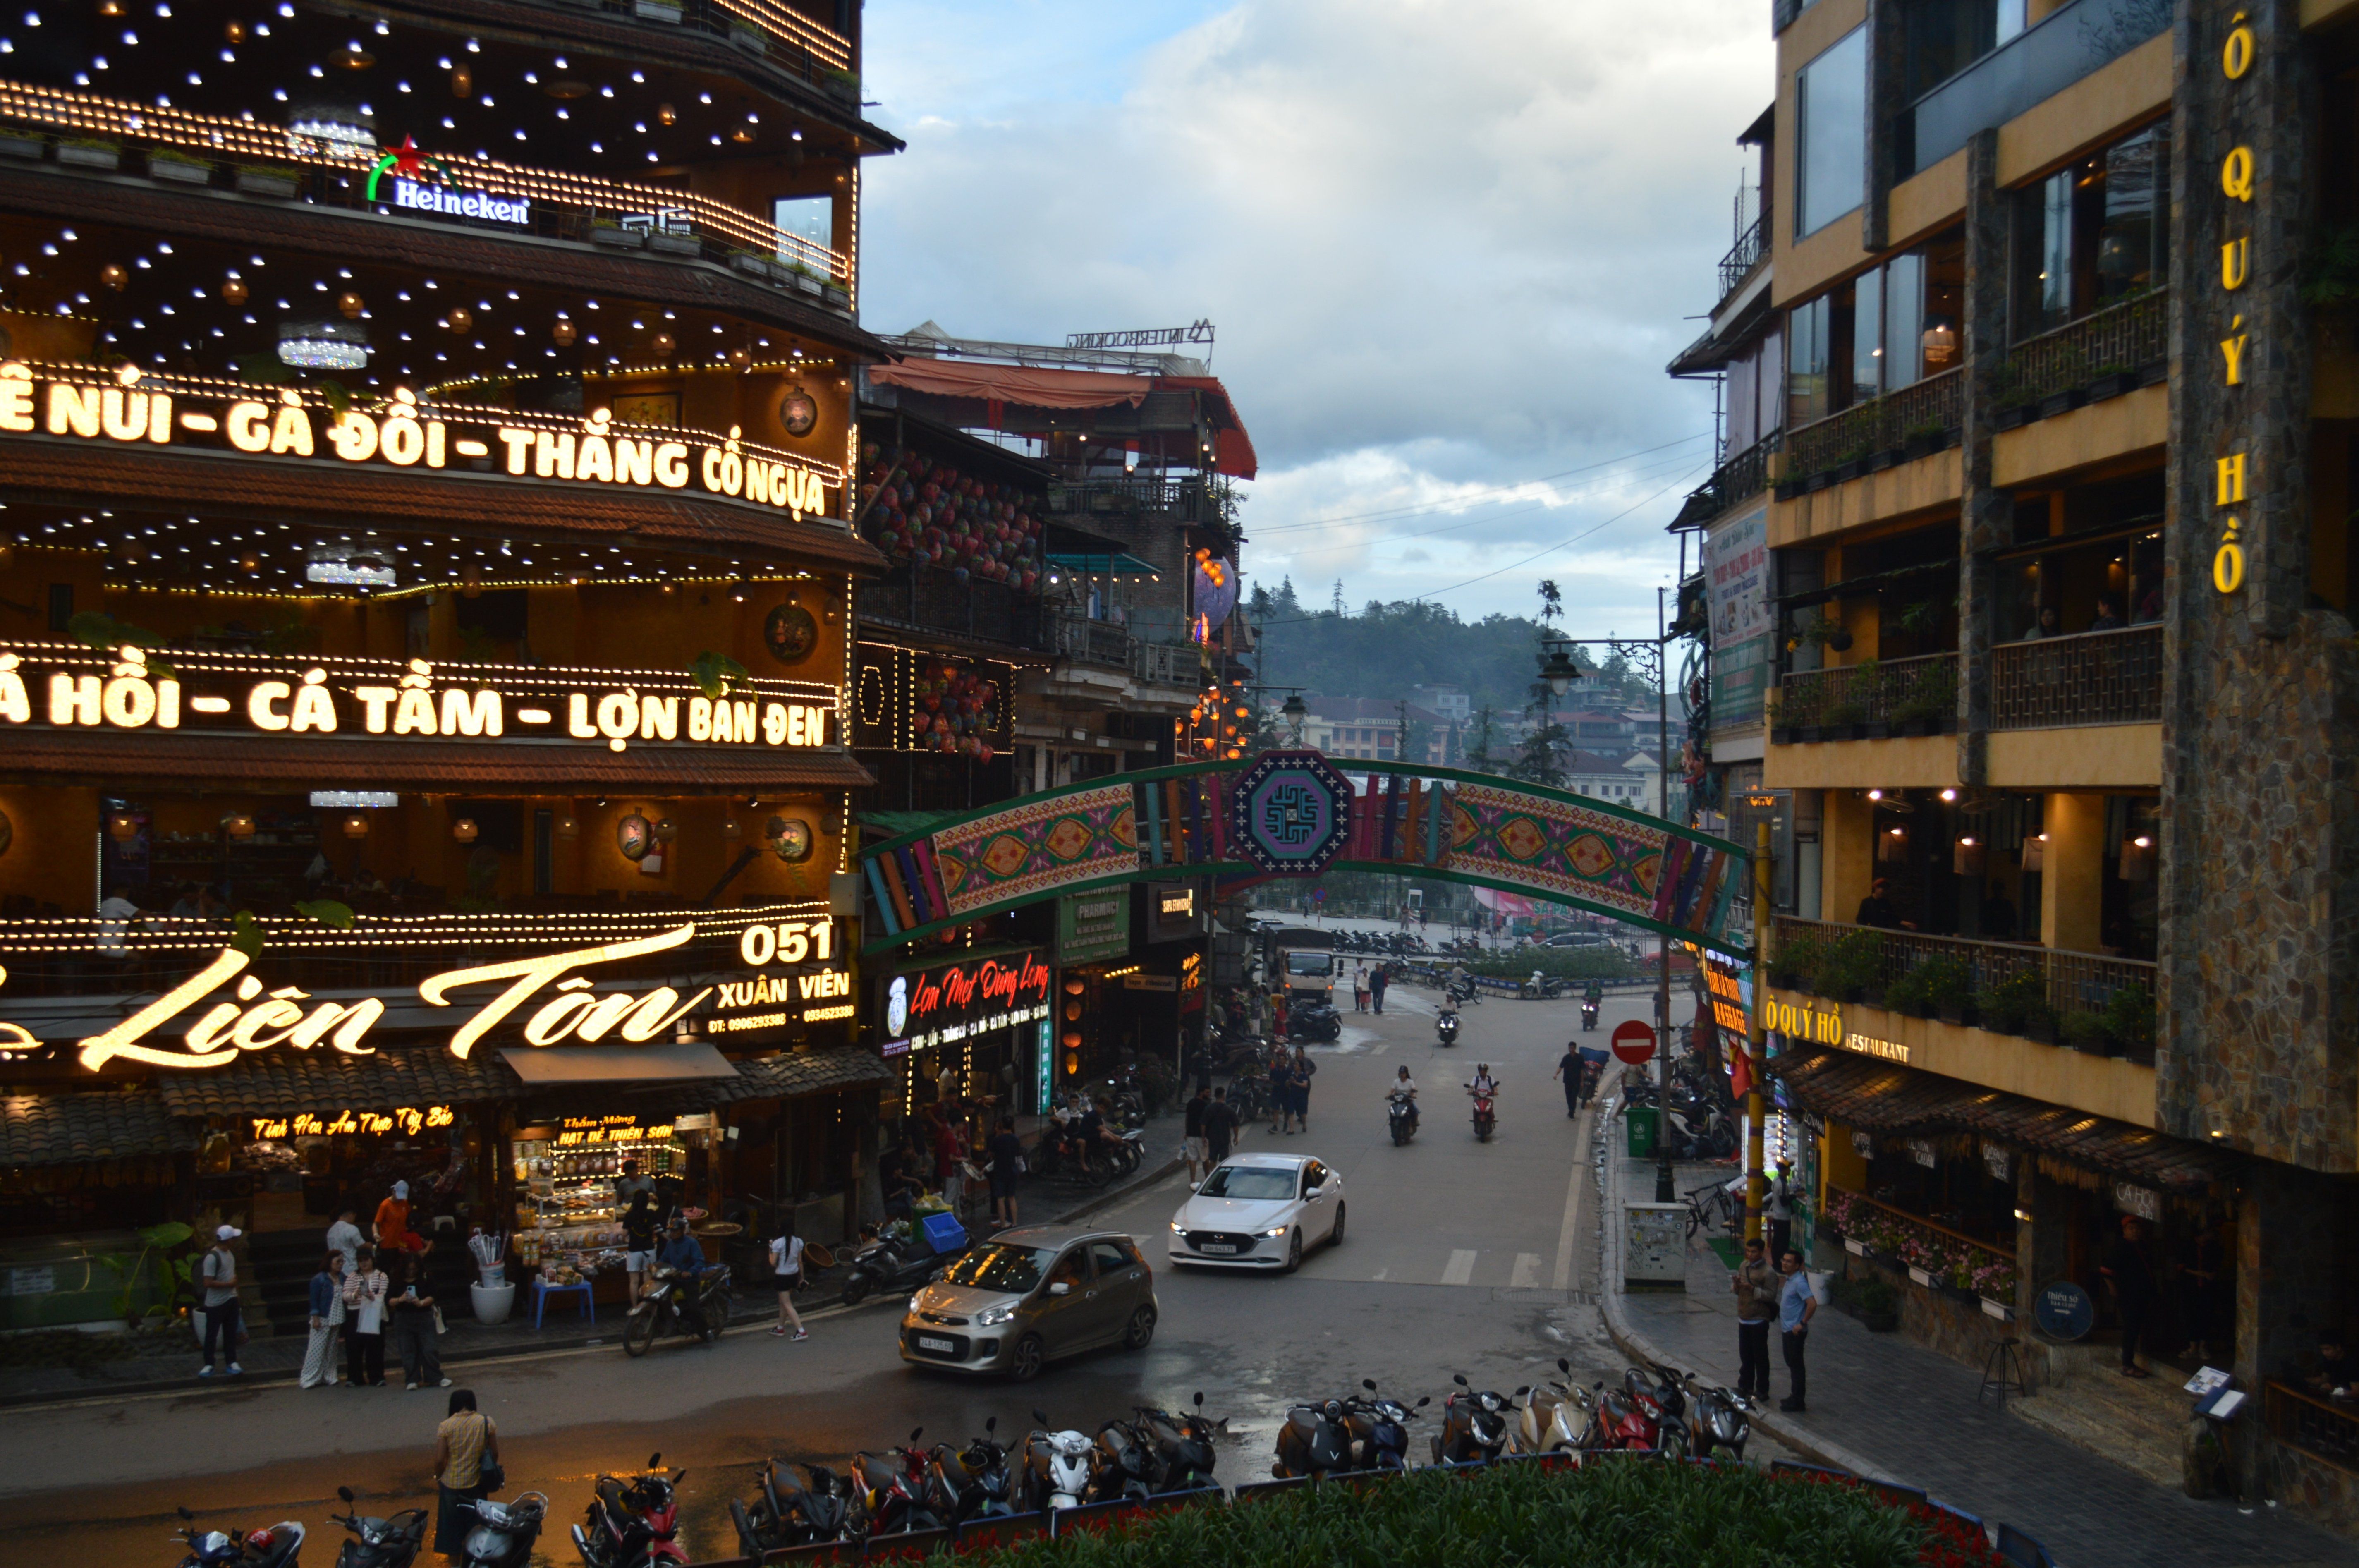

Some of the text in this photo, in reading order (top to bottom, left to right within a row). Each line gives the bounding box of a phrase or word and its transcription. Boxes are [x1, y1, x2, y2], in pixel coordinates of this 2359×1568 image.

[2222, 9, 2255, 81] Ô
[396, 182, 534, 225] Heineken
[48, 363, 172, 444] NÚI
[227, 388, 315, 457] GÀ
[325, 386, 446, 469] ĐỒI
[498, 407, 689, 488] THẮNG
[702, 424, 743, 496] CỐ
[744, 459, 826, 523] NGỰA
[2212, 452, 2249, 595] HỒ
[48, 644, 181, 729] HỒI
[247, 667, 338, 732] CÁ
[354, 658, 504, 737] TẦM
[568, 687, 679, 752] LỢN
[761, 702, 825, 747] ĐEN
[1078, 901, 1120, 920] PHARMACY
[1534, 900, 1549, 913] SA
[740, 920, 831, 966] 051
[78, 947, 385, 1073] Liên
[418, 920, 713, 1060] Tôn
[717, 967, 850, 1009] XUÂN VIÊN
[1019, 952, 1049, 1000] Long
[727, 1013, 787, 1032] 0906293388
[803, 1005, 855, 1022] 0934523388
[1713, 1001, 1747, 1035] MASSAGE
[1765, 994, 1842, 1045] Ô QUÝ HỒ
[1846, 1033, 1909, 1063] RESTAURANT
[559, 1125, 674, 1147] HẠT DẺ THIÊN SƠN
